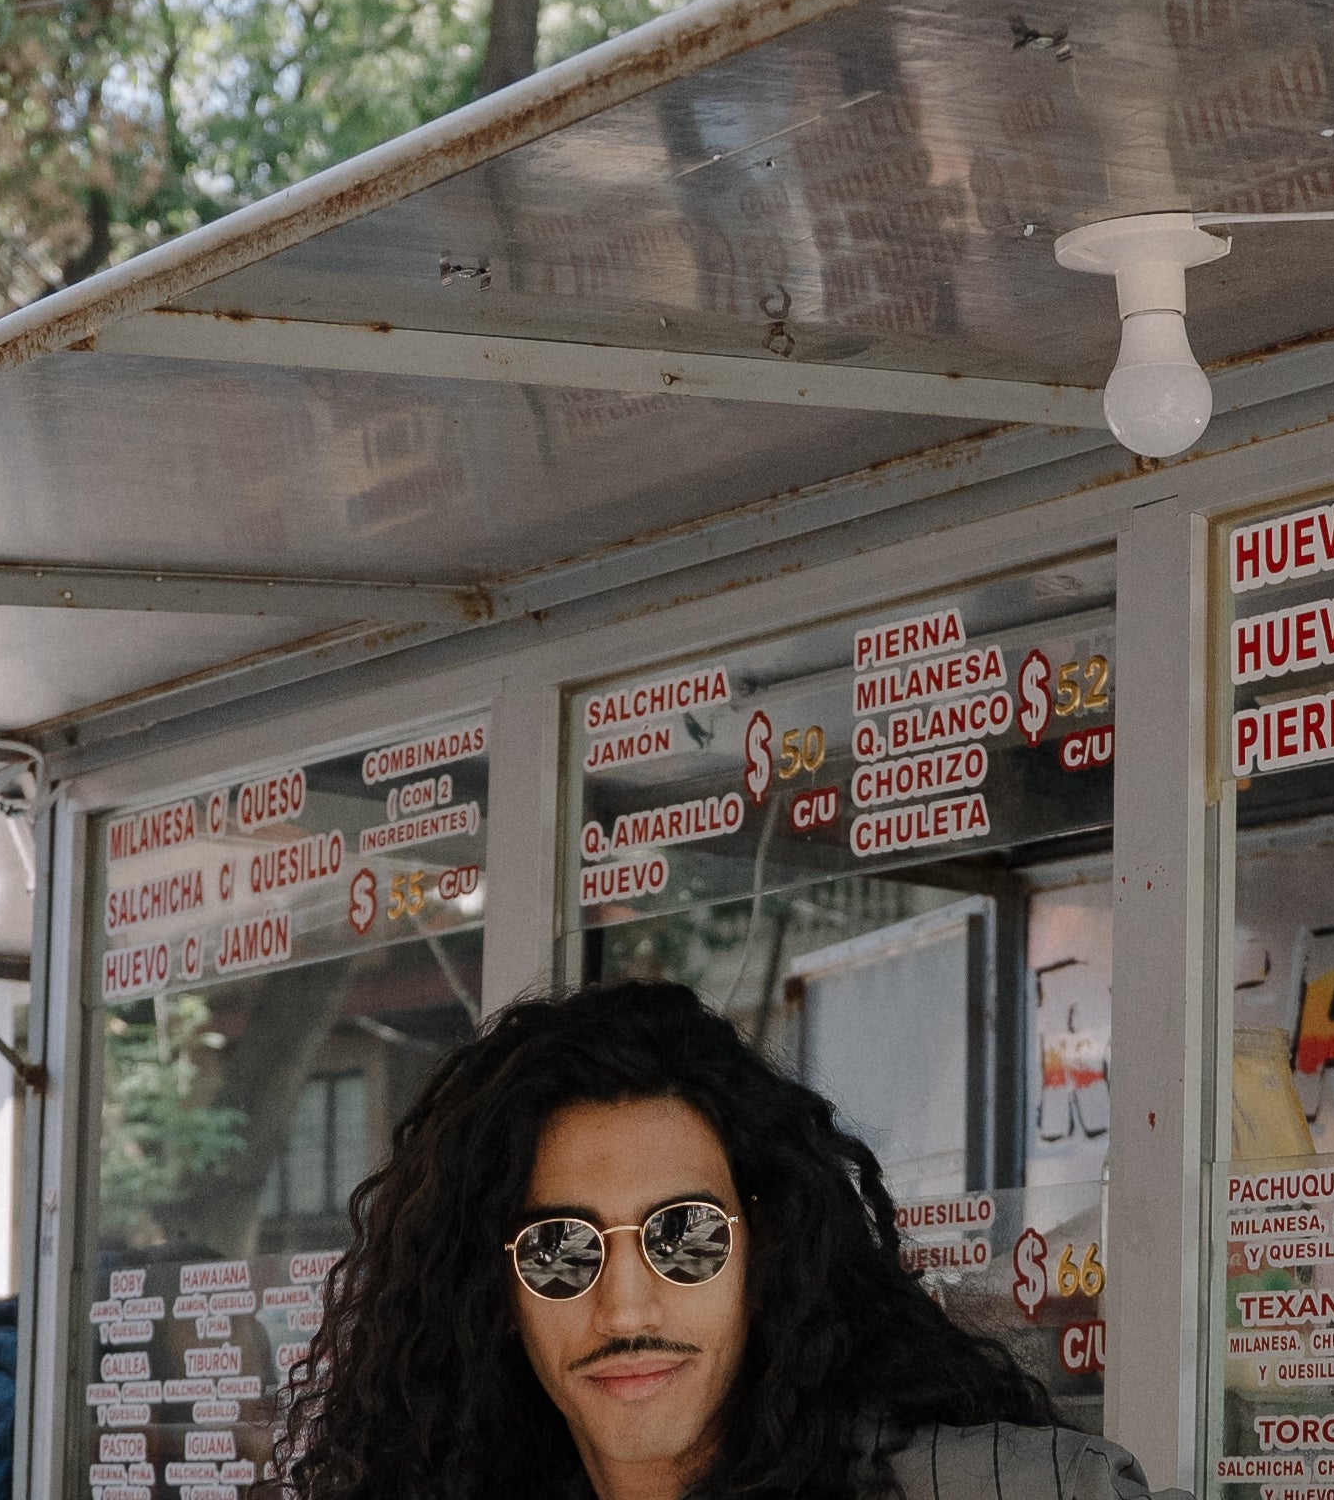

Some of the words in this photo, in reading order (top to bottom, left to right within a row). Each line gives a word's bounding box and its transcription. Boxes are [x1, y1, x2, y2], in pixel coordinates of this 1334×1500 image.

[857, 612, 962, 667] PIERNA
[588, 671, 728, 729] SALCHICHA
[857, 650, 1003, 711] MILANESA
[1019, 654, 1051, 743] $
[1055, 655, 1108, 716] 52
[587, 724, 672, 768] JAMÓN
[856, 727, 882, 756] Q.
[892, 695, 1010, 749] BLANCO
[364, 726, 485, 779] COMBINADAS
[743, 711, 774, 807] $
[779, 725, 825, 779] 50
[1061, 731, 1115, 767] C/U
[401, 786, 434, 809] CON
[438, 778, 452, 801] 2
[855, 748, 986, 803] CHORIZO
[109, 804, 197, 859] MILANESA
[239, 772, 305, 827] QUESO
[584, 826, 607, 854] Q.
[614, 798, 741, 848] AMARILLO
[791, 794, 838, 830] C/U
[855, 799, 987, 852] CHULETA
[108, 870, 205, 929] SALCHICHA
[249, 833, 343, 895] QUESILLO
[387, 870, 424, 918] 55
[582, 860, 665, 899] HUEVO
[105, 944, 168, 989] HUEVO
[896, 1199, 993, 1229] QUESILLO
[1230, 1214, 1326, 1236] MILANESA,
[900, 1242, 986, 1269] UESILLO
[1014, 1229, 1047, 1316] $
[1057, 1243, 1104, 1296] 66
[1249, 1248, 1260, 1262] Y
[113, 1275, 143, 1291] BOBY
[1258, 1365, 1268, 1381] Y
[102, 1438, 144, 1456] PASTOR
[188, 1435, 233, 1454] IGUANA
[1217, 1460, 1305, 1478] SALCHICHA
